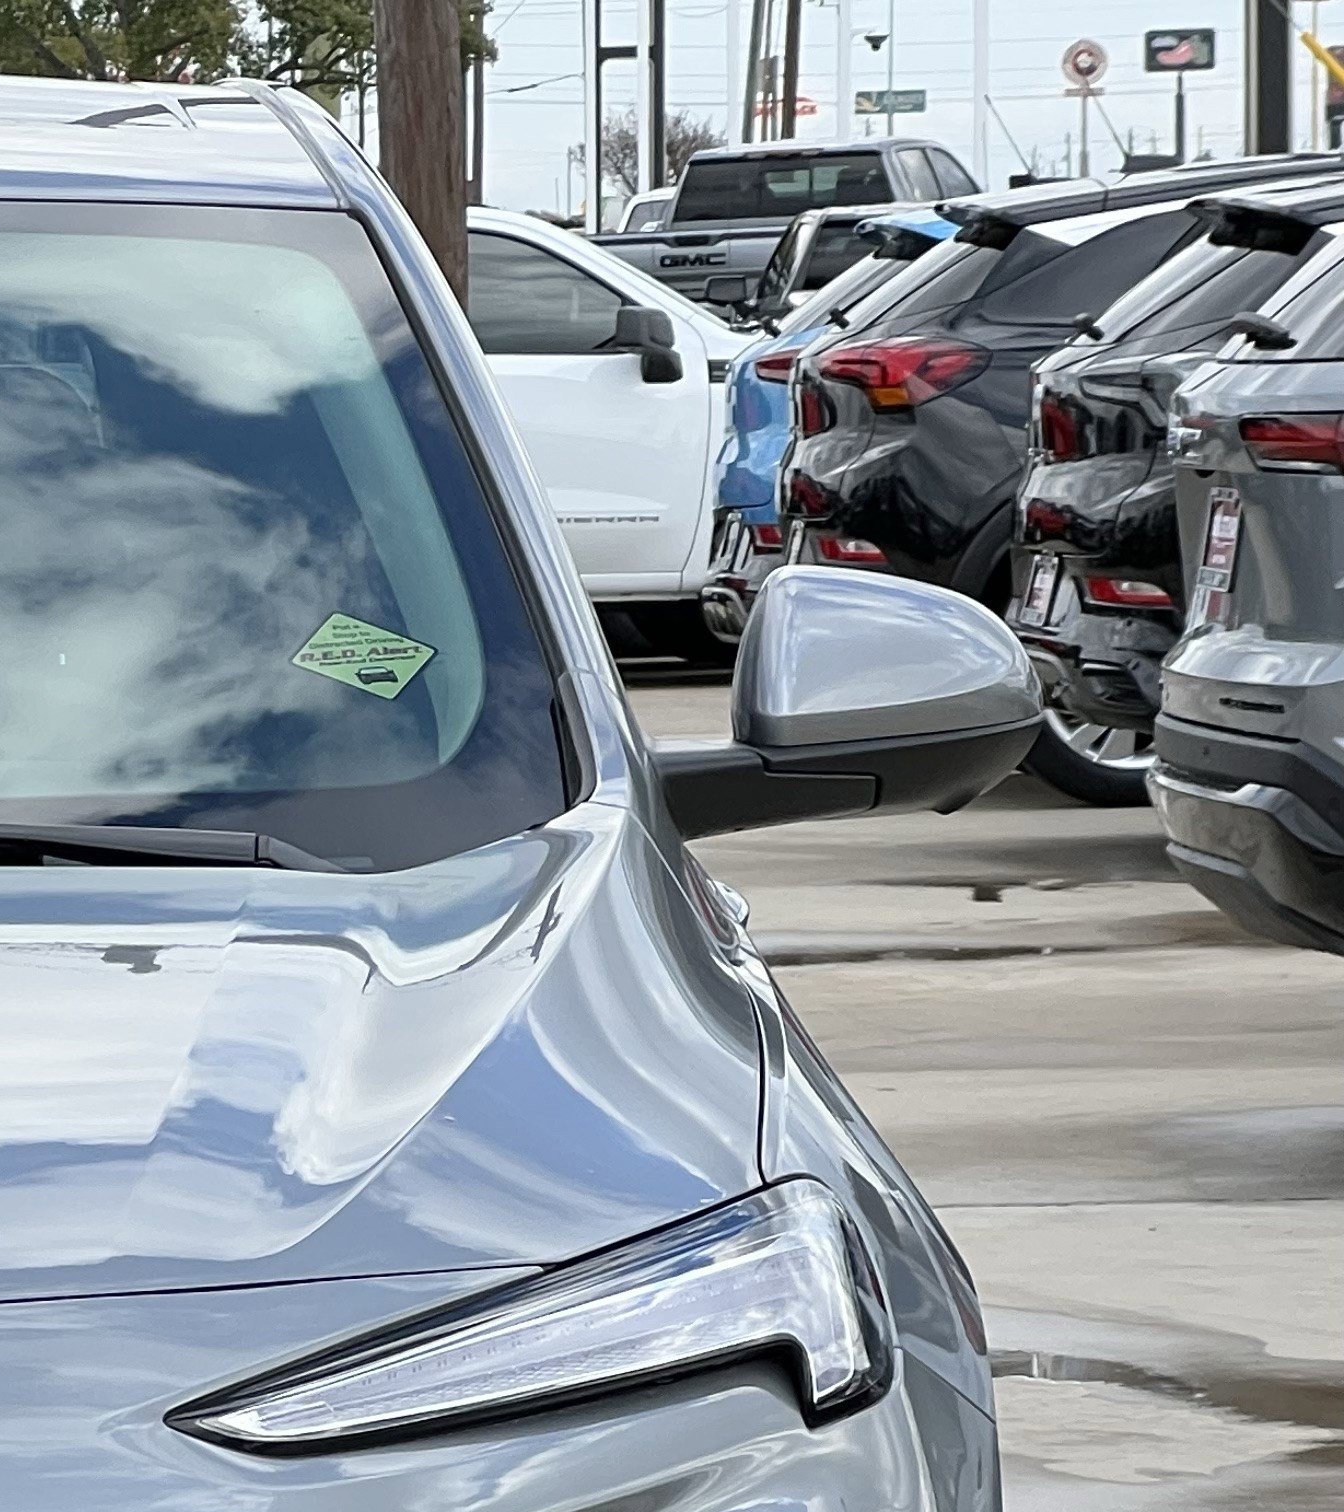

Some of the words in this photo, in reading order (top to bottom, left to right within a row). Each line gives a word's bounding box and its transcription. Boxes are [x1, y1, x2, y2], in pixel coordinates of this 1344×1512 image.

[659, 253, 726, 267] GMC
[300, 649, 363, 662] R.E.D.
[367, 646, 422, 657] Alert
